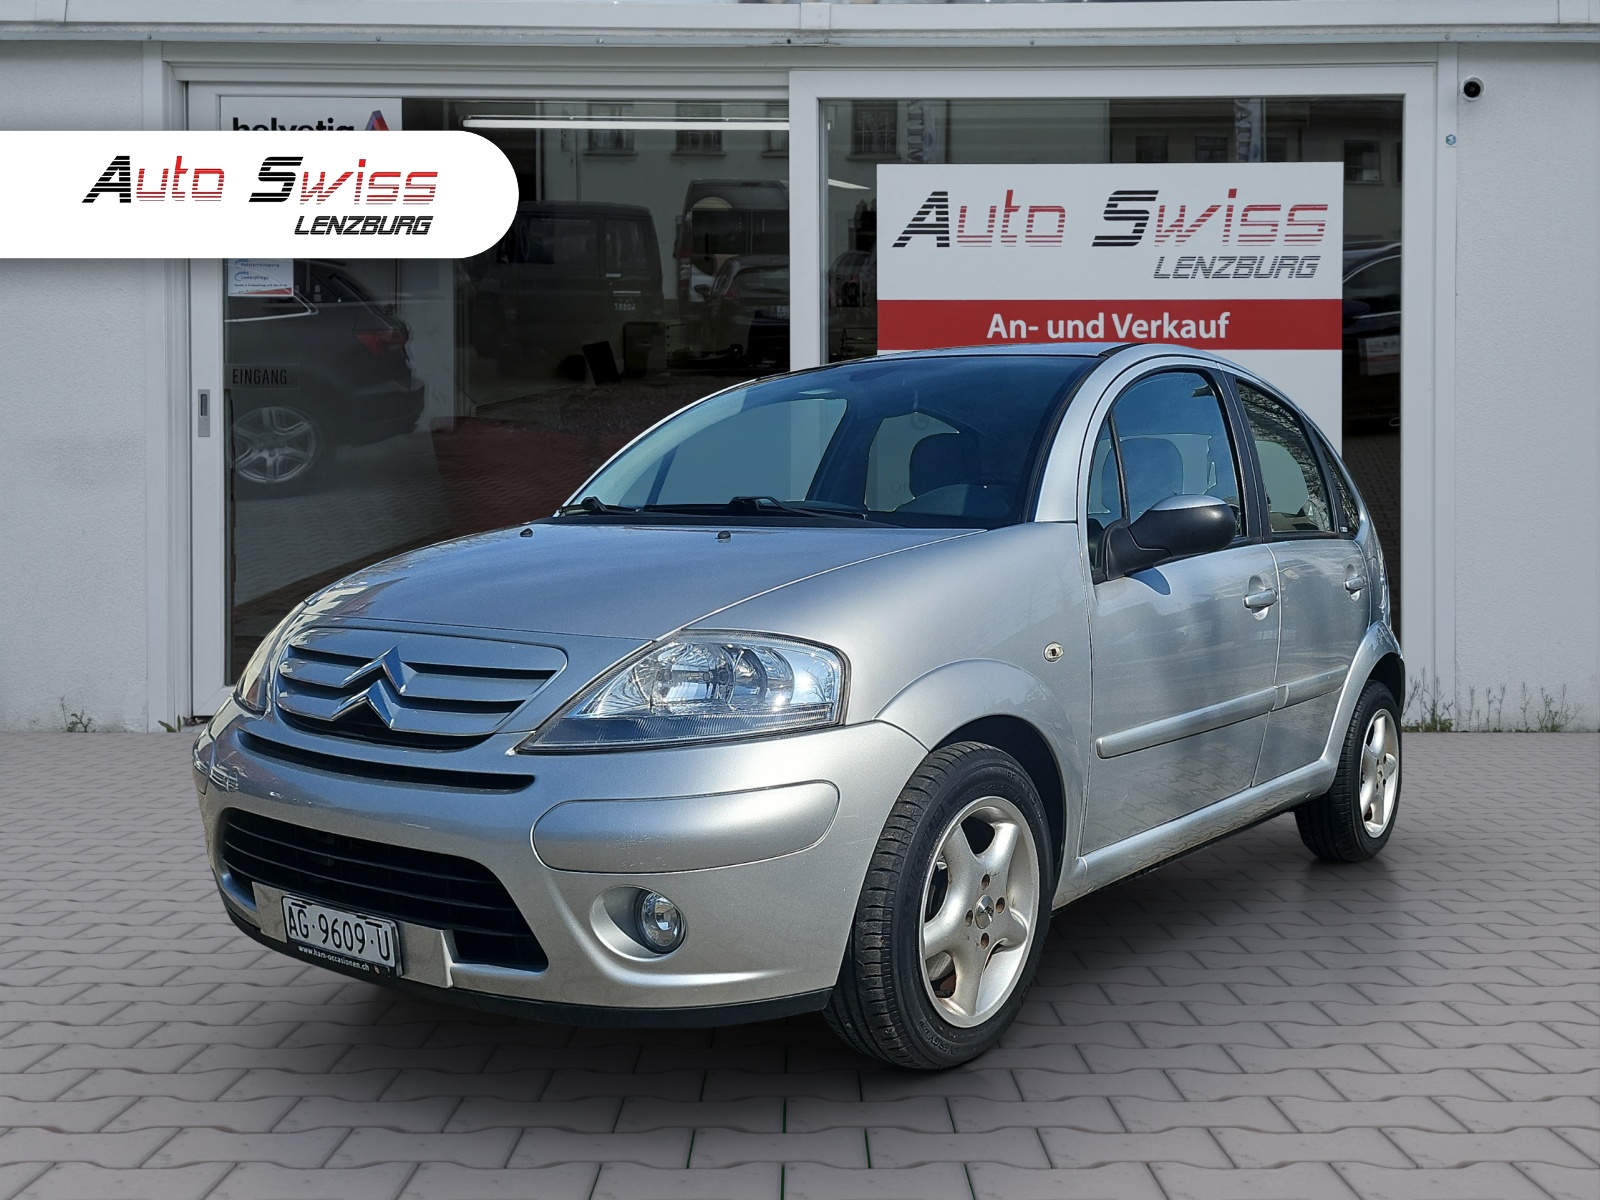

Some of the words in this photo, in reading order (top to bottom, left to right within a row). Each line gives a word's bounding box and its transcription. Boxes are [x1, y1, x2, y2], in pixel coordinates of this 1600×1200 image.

[891, 188, 1066, 248] Auto
[1091, 187, 1329, 247] Swiss
[1153, 255, 1322, 280] LENZBURG
[986, 313, 1039, 339] An-
[1047, 312, 1104, 340] und
[1111, 311, 1231, 340] Verkauf
[232, 368, 288, 385] EINGANG
[318, 914, 366, 954] 9609
